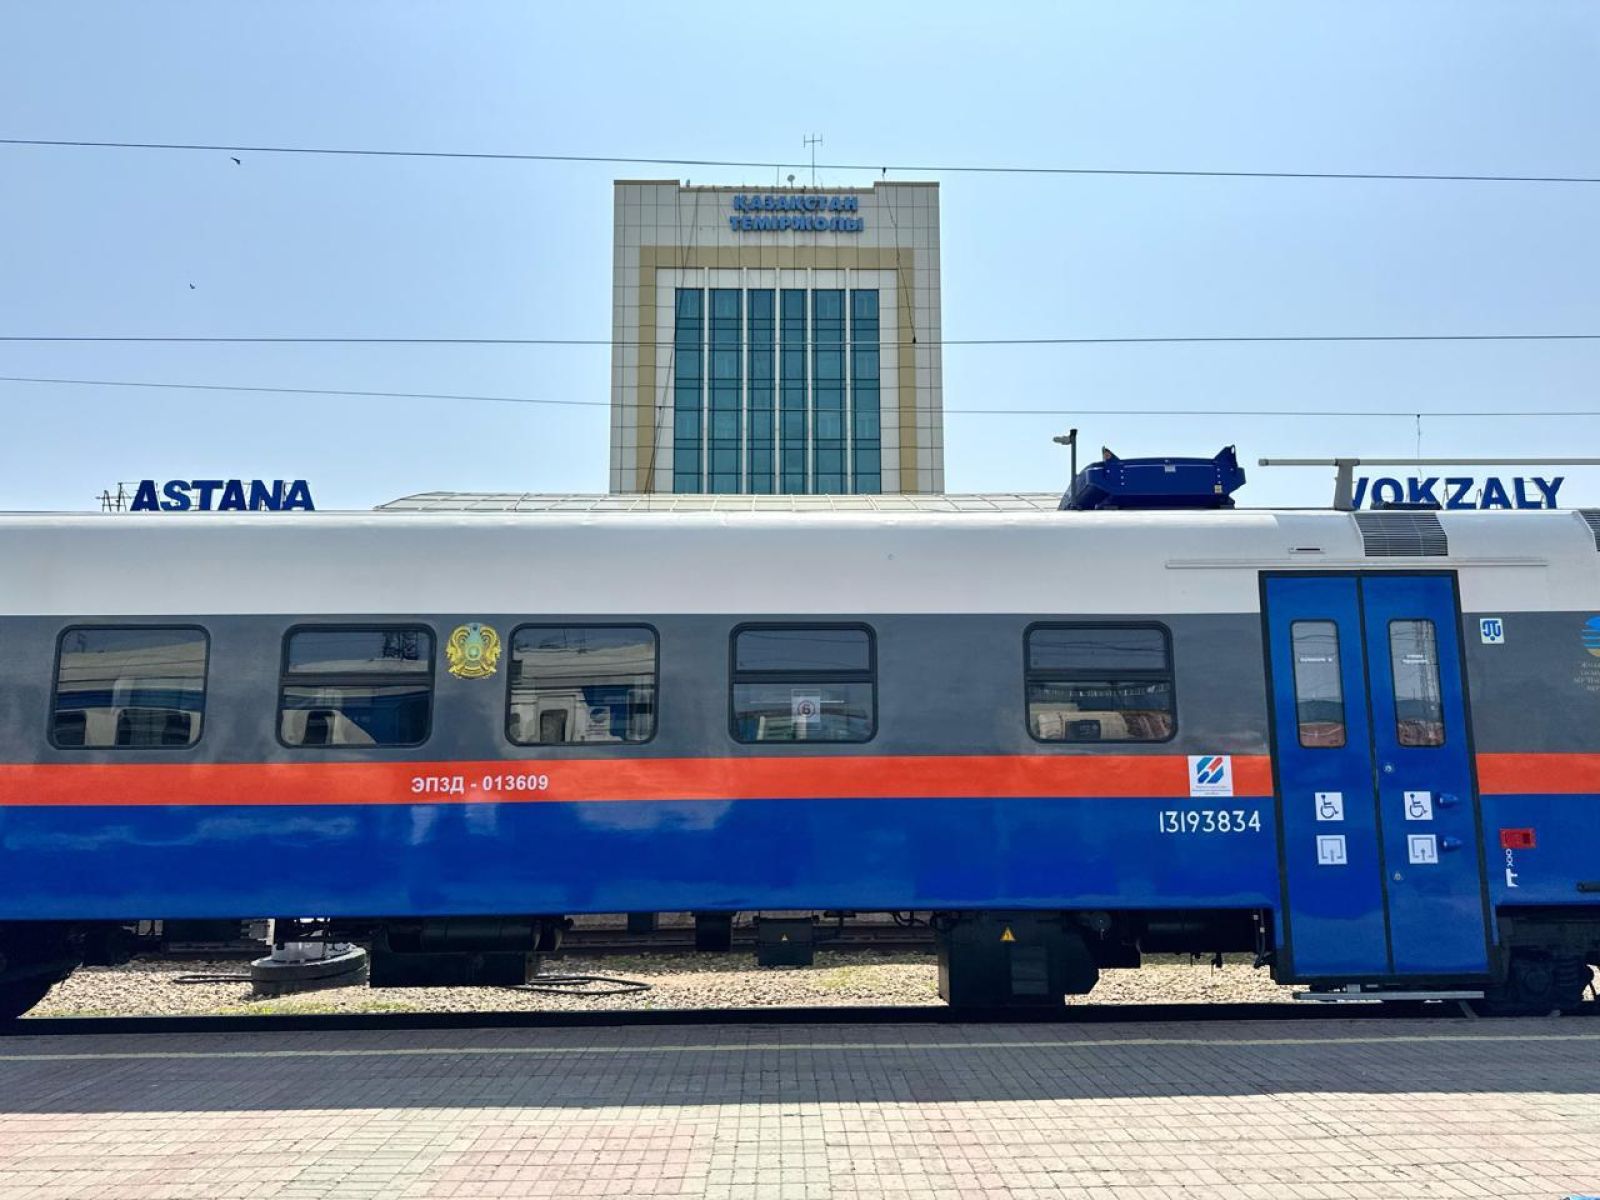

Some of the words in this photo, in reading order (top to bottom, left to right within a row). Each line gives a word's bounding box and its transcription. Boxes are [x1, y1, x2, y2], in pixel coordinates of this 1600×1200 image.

[129, 479, 315, 511] ASTANA
[482, 775, 549, 791] 013609
[1159, 810, 1261, 833] 13193834
